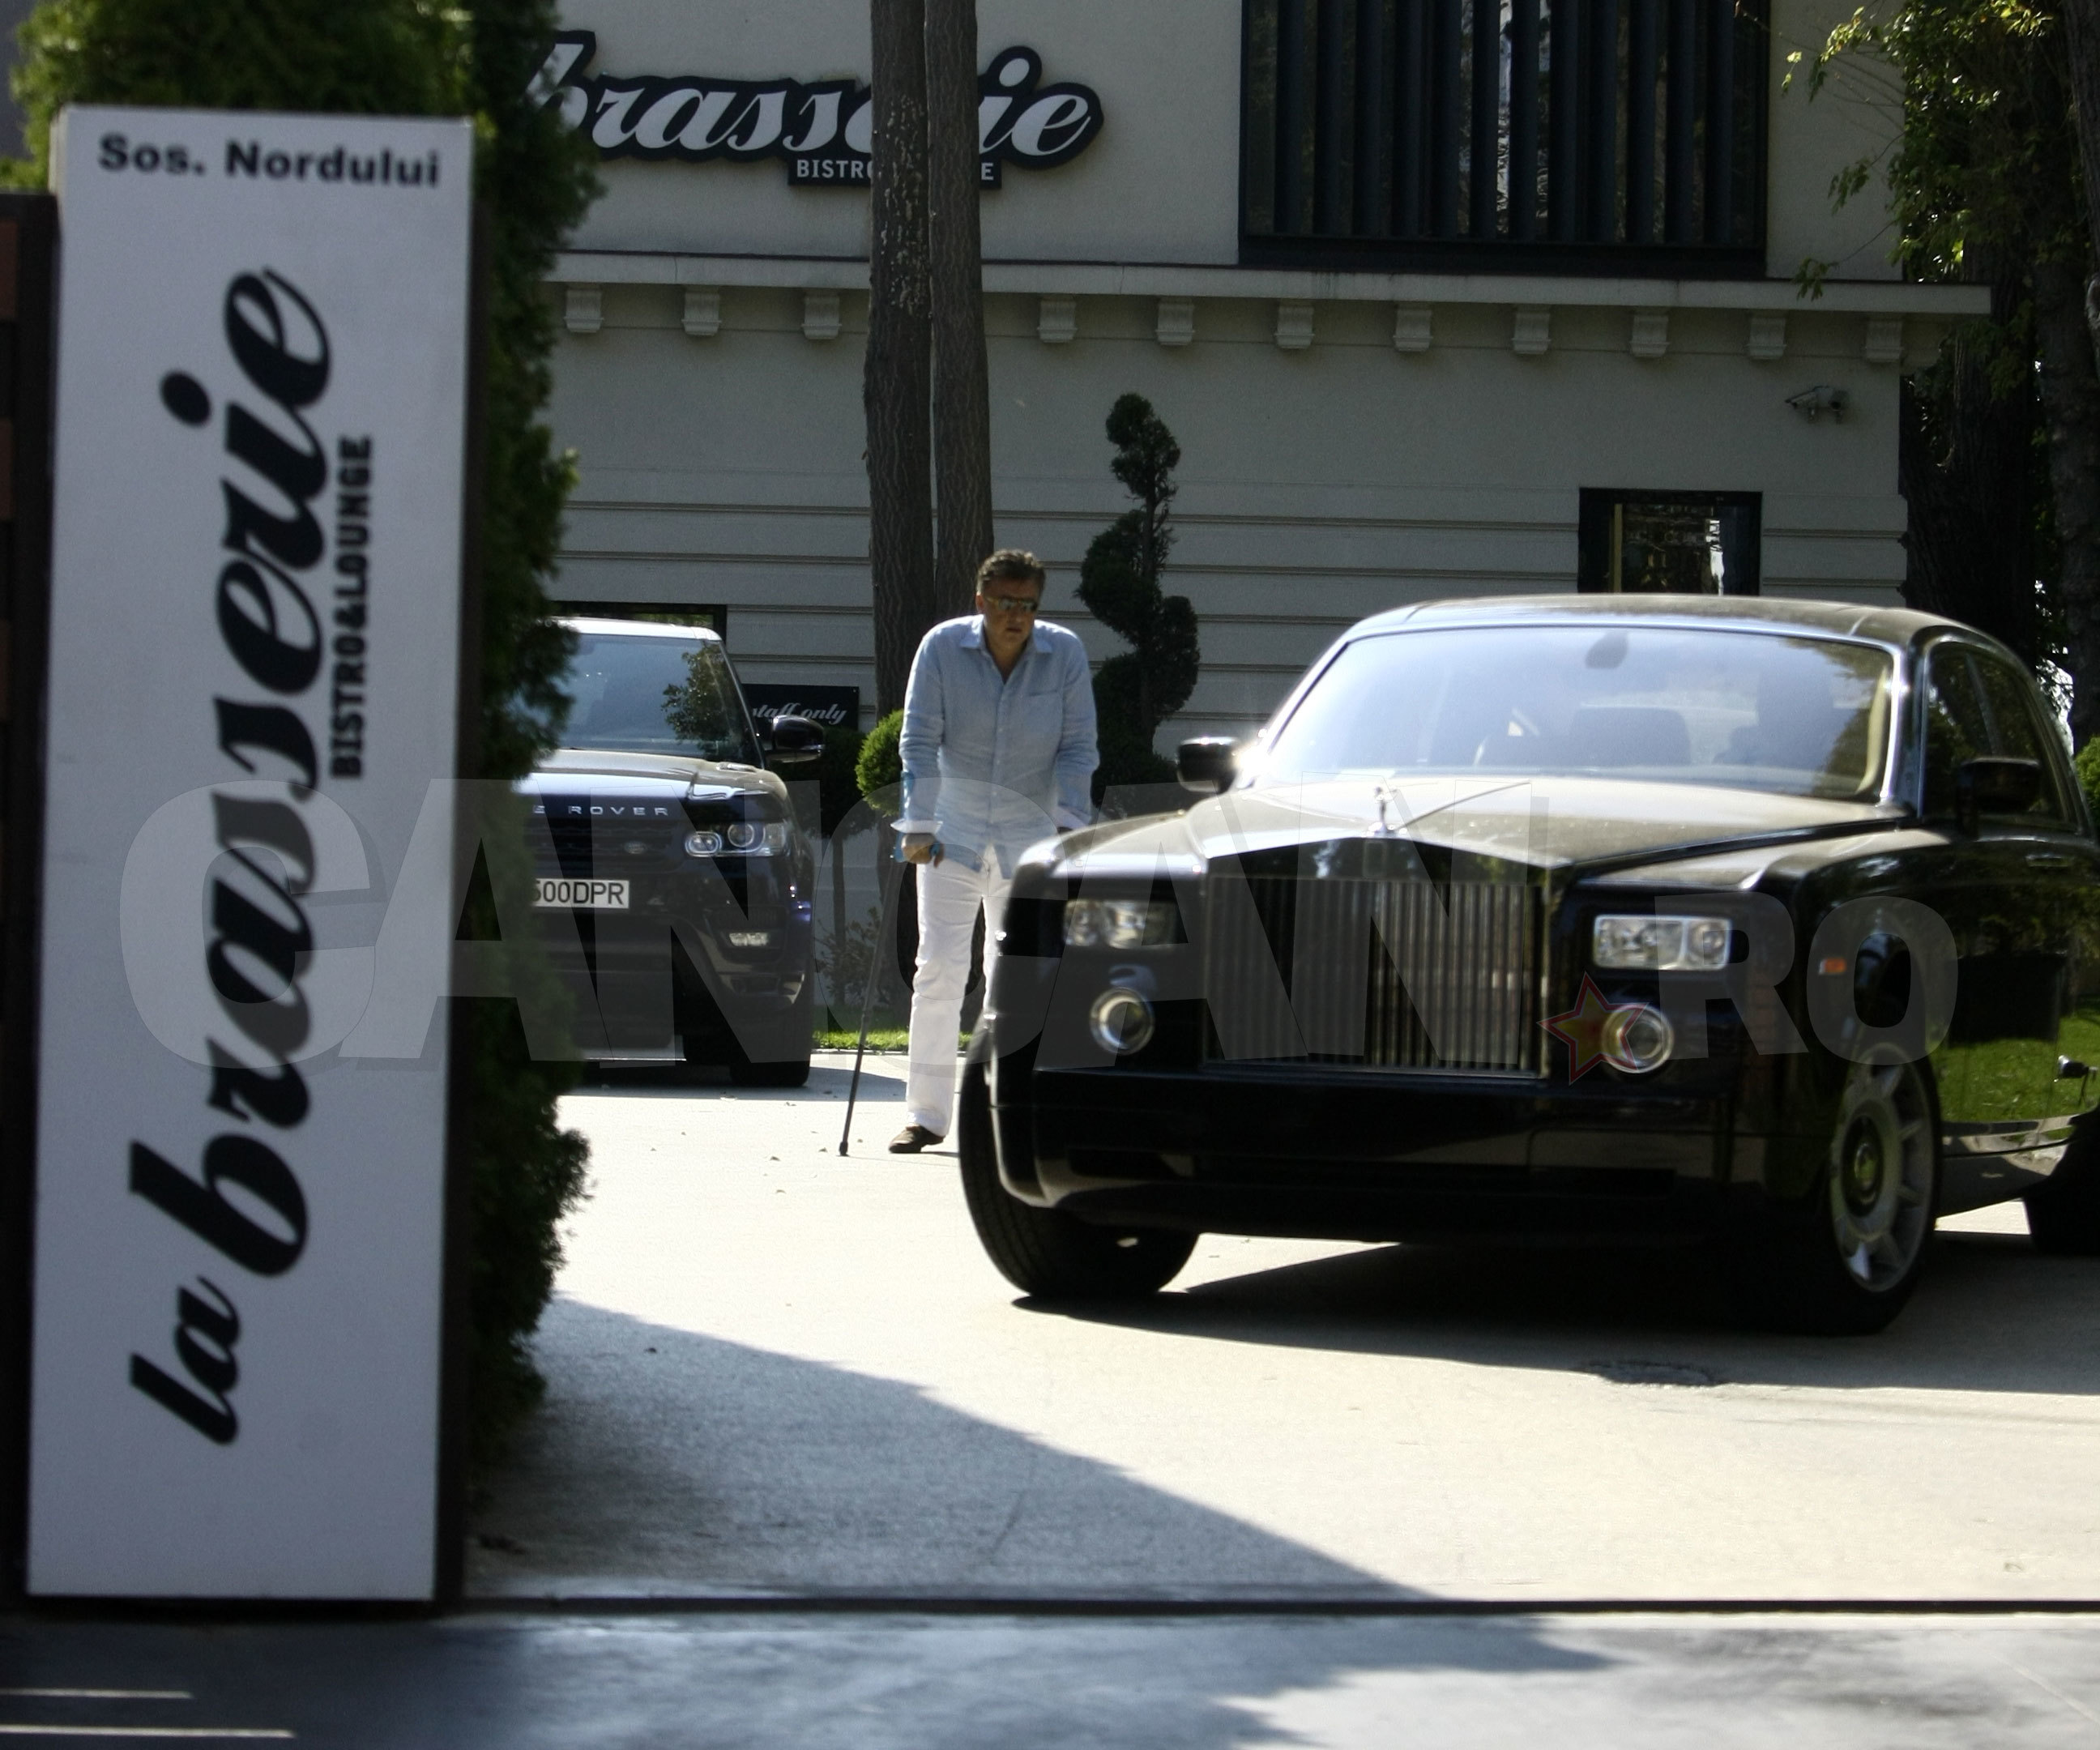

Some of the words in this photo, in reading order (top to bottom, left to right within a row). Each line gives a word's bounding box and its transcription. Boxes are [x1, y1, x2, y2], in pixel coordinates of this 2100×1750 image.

[527, 43, 1091, 156] brassie
[99, 132, 205, 176] Sos.
[224, 138, 441, 188] Nordului
[330, 433, 372, 780] BISTRO&LOUNGE
[800, 703, 847, 725] only
[128, 267, 331, 1278] brasserie
[567, 805, 668, 816] ROVER
[128, 1274, 241, 1447] la
